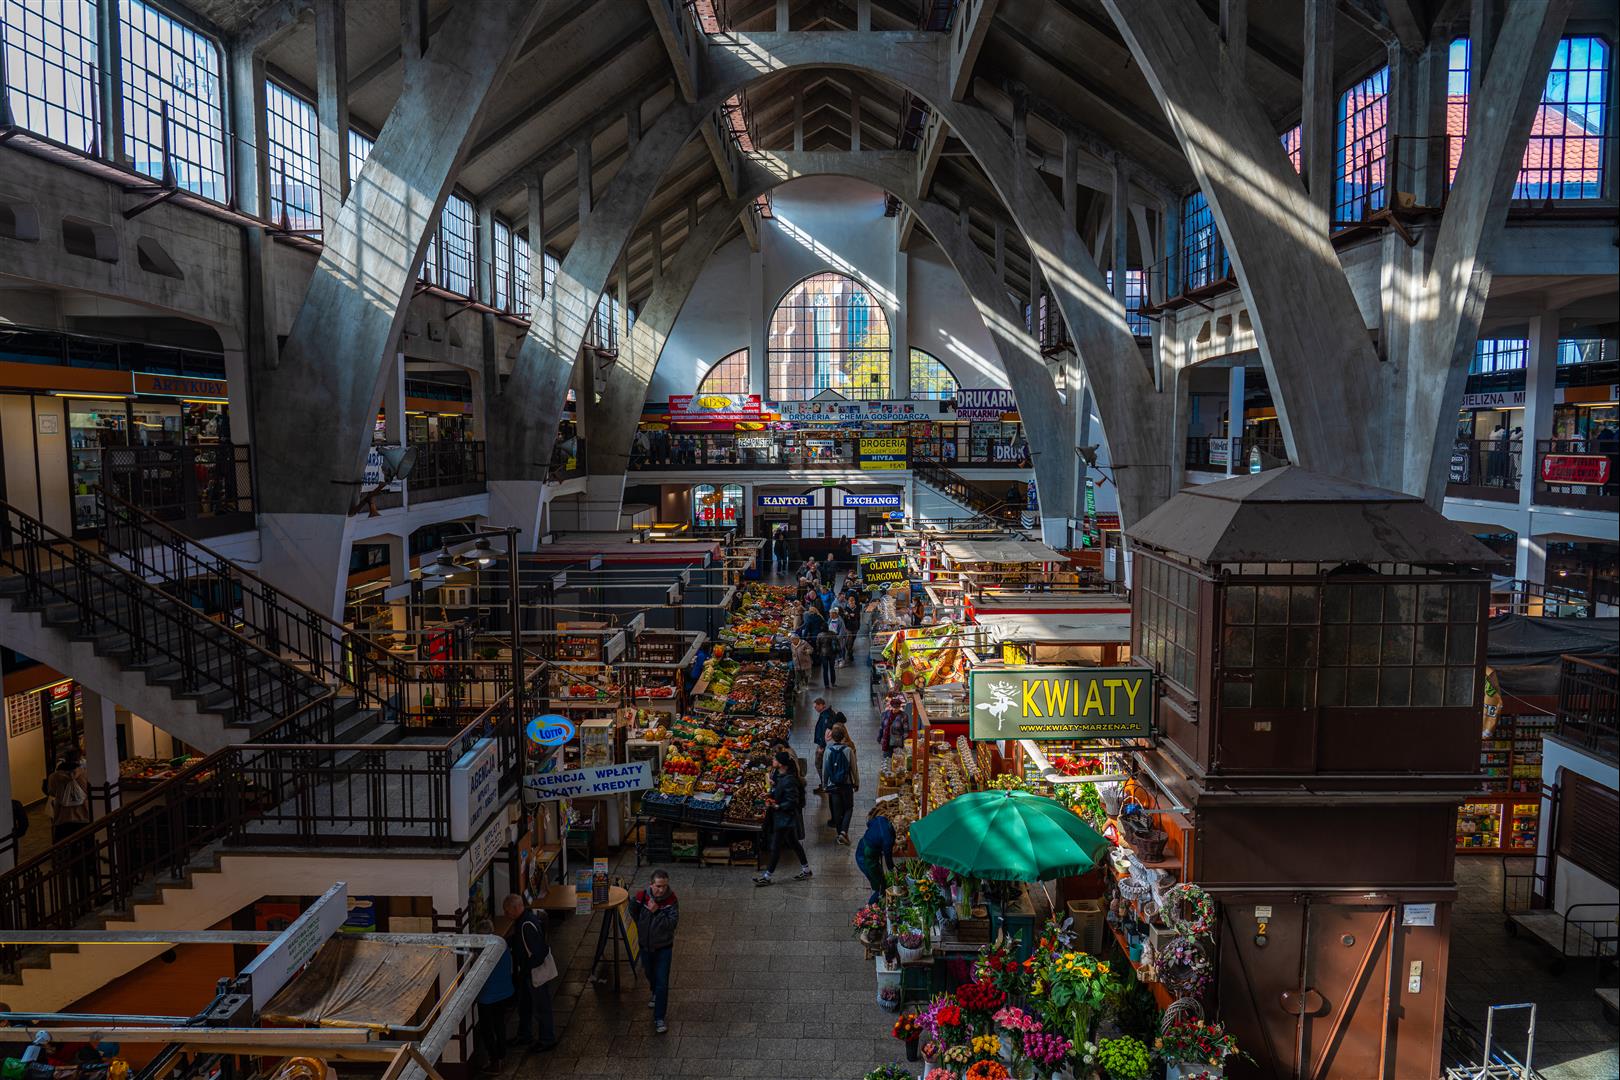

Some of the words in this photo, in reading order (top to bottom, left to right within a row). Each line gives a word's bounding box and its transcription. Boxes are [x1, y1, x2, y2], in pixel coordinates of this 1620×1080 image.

[789, 413, 830, 421] DROGERIA
[957, 409, 1000, 418] DRUKARNIA
[861, 439, 906, 448] DROGERIA
[763, 496, 808, 505] KANTOR
[845, 496, 899, 505] EXCHANGE
[703, 507, 736, 520] BAR
[869, 560, 898, 571] OLIWKI
[866, 571, 904, 582] TARGOWA
[1022, 678, 1144, 717] KWIATY
[1019, 722, 1142, 732] WWW.KWIATY-MARZENA.PL
[470, 753, 496, 794] AGENCJA
[530, 772, 586, 787] AGENCJA
[595, 765, 643, 779] WPŁATY
[536, 785, 582, 799] LOKATY
[593, 778, 641, 792] KREDYT
[1258, 923, 1266, 935] 2
